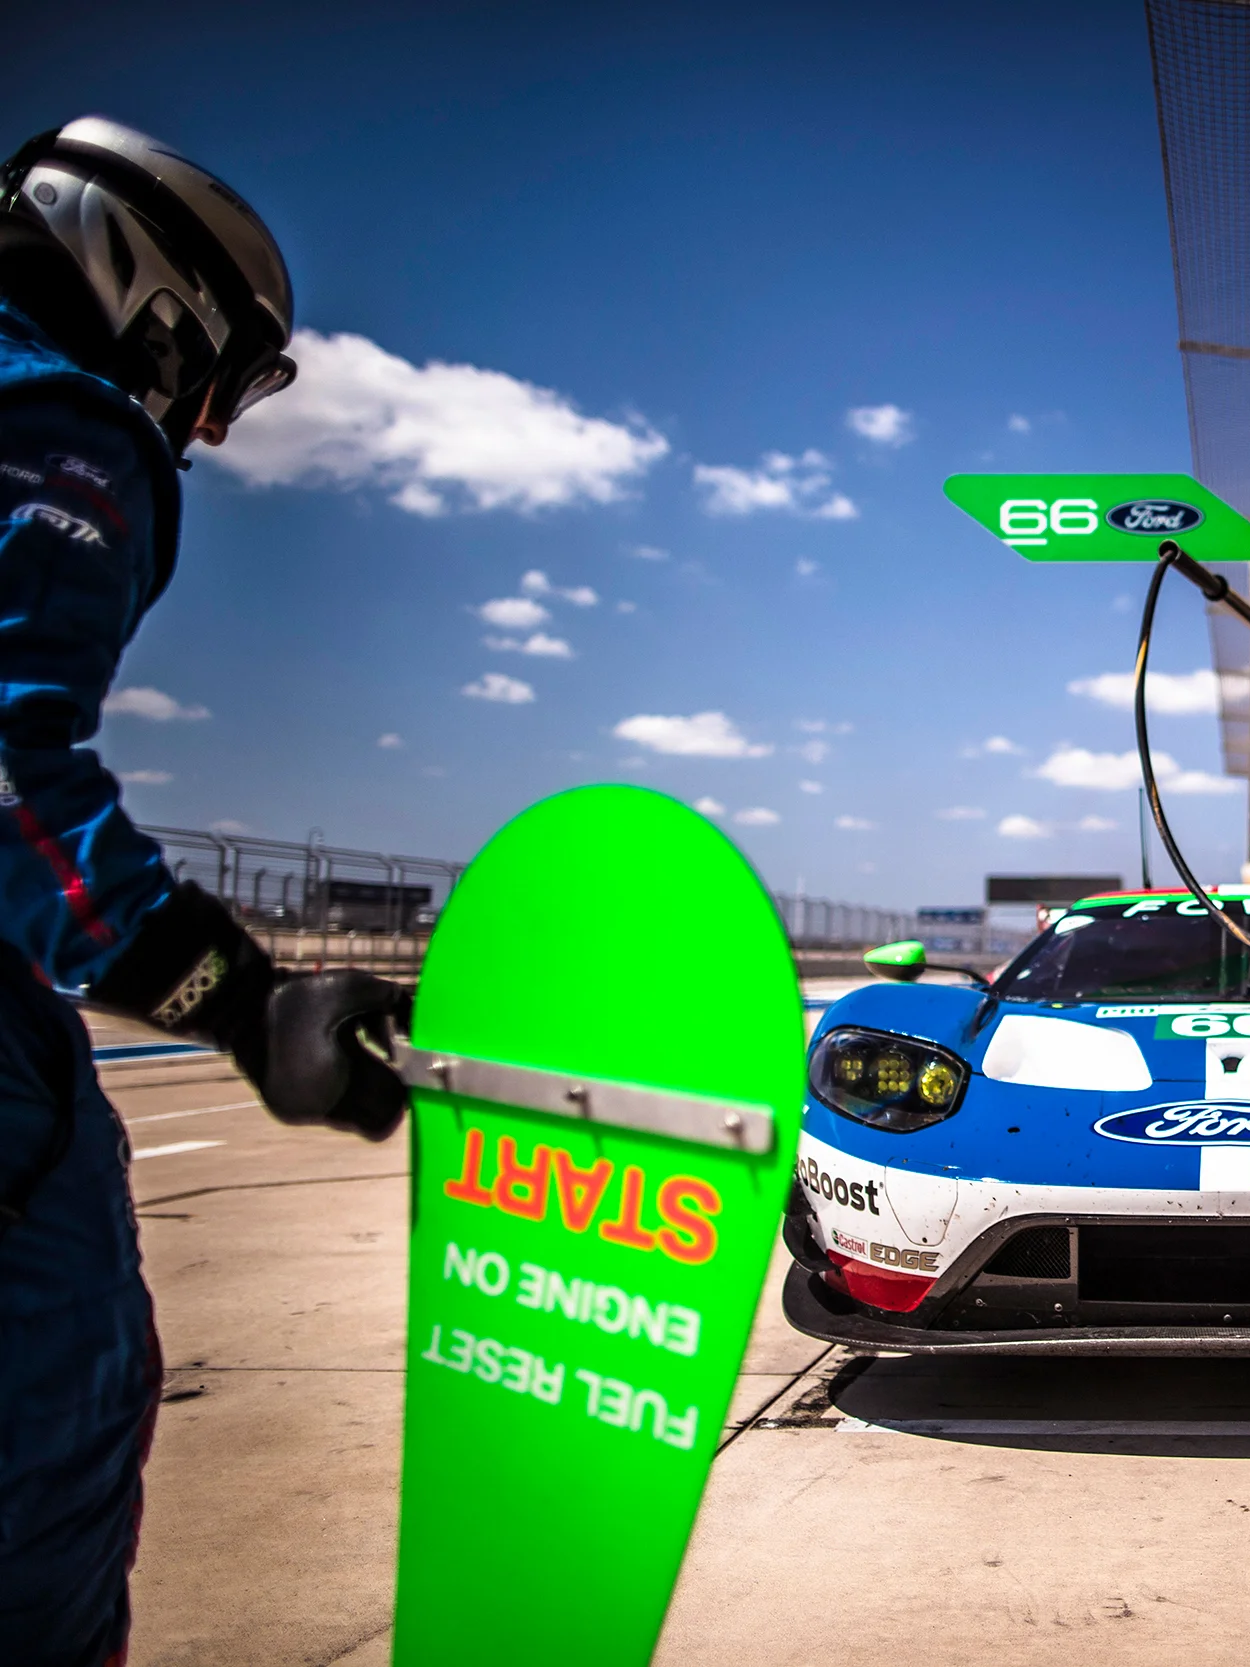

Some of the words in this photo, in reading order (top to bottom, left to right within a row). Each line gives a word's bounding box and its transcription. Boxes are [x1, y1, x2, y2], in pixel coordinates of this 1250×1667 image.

[1000, 498, 1099, 536] 66
[1124, 503, 1186, 530] Ford
[443, 1127, 723, 1266] START
[443, 1241, 511, 1297] ON
[838, 1233, 867, 1256] Castrol
[869, 1242, 941, 1272] EDGE
[515, 1261, 702, 1358] ENGINE
[420, 1324, 566, 1406] RESET
[574, 1368, 700, 1452] FUEL
